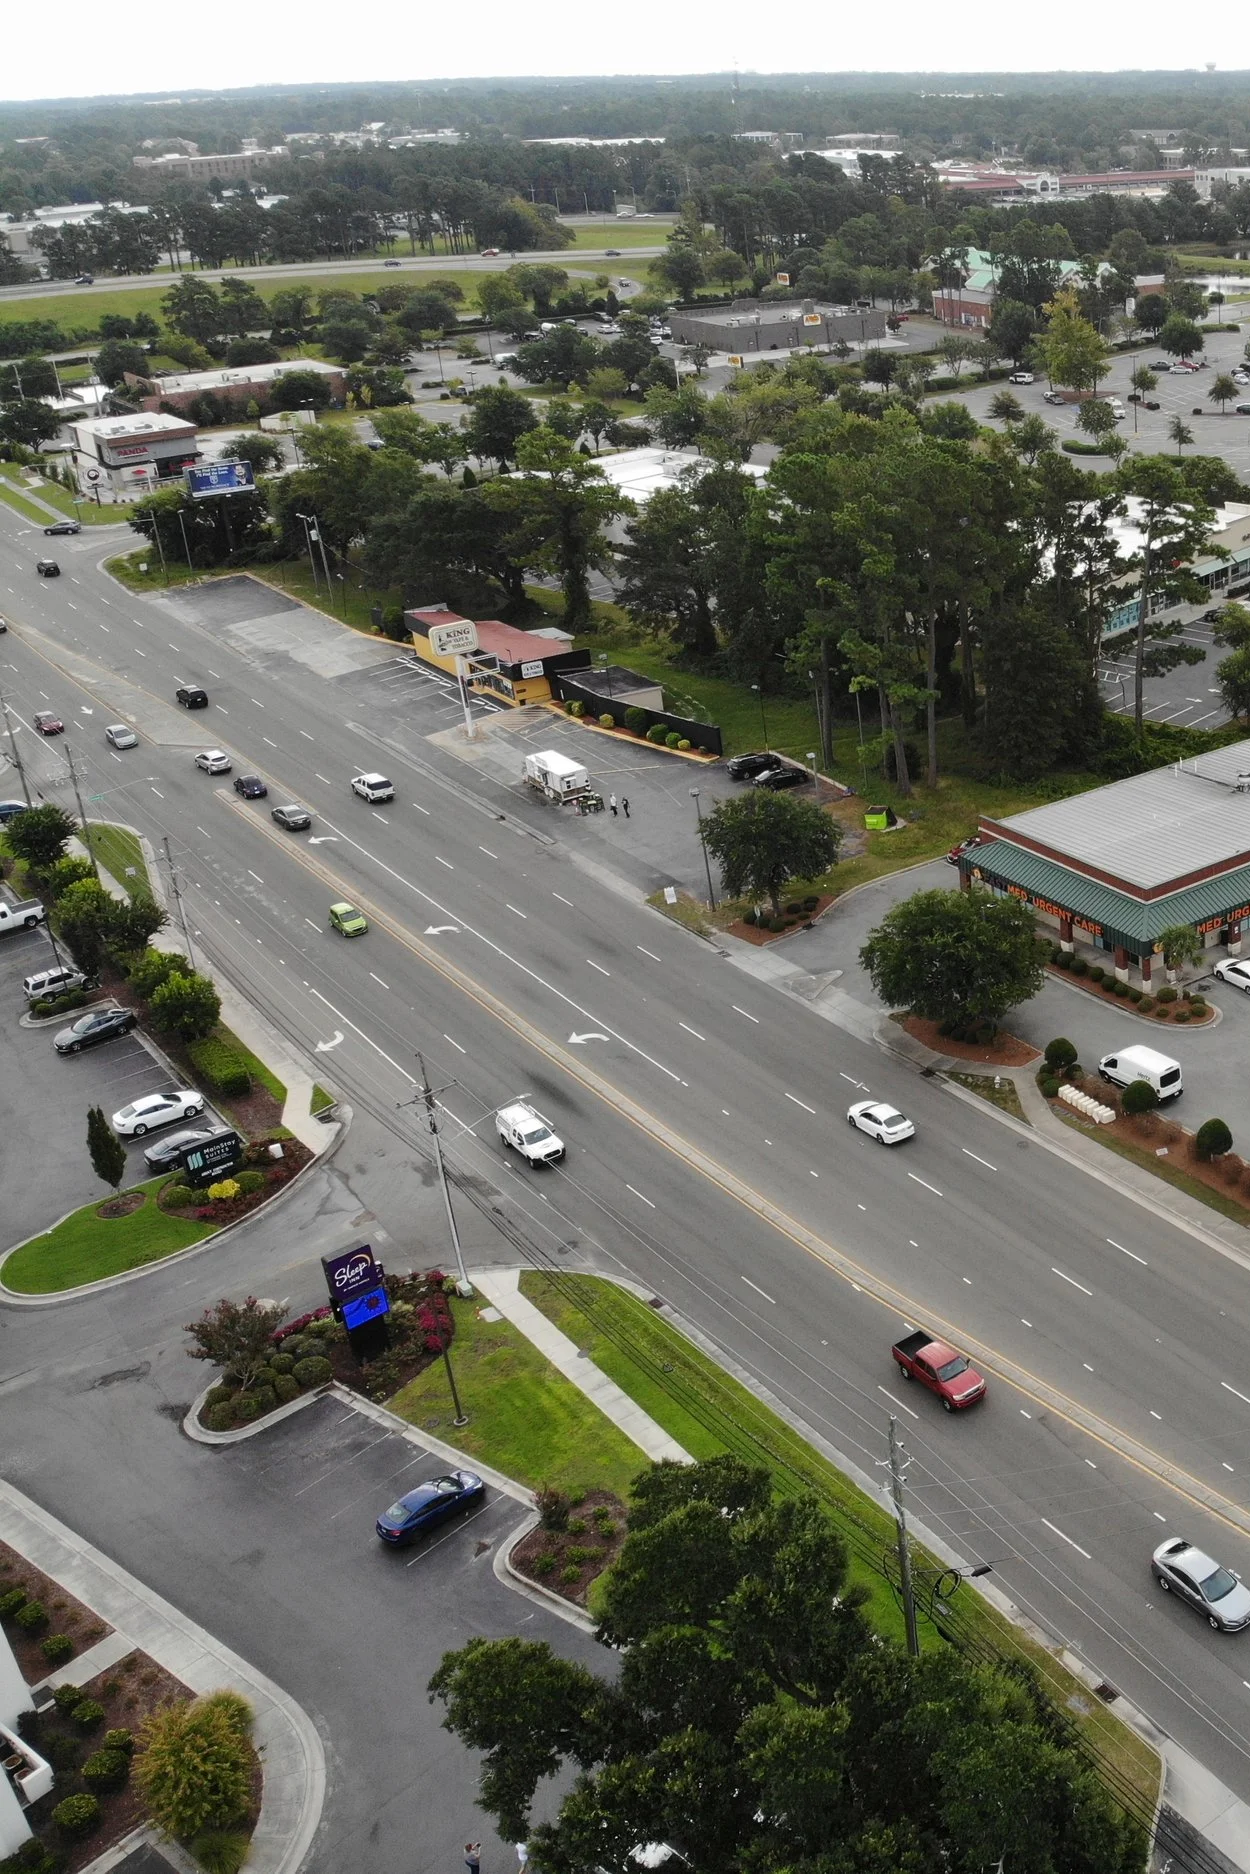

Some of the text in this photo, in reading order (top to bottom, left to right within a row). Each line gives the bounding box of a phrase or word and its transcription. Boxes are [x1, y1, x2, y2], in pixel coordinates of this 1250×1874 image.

[117, 446, 149, 456] PANDA
[1033, 895, 1072, 922] URGENT
[1074, 916, 1102, 936] CARE
[1136, 1071, 1151, 1081] Hertz
[204, 1140, 235, 1154] MainStay
[205, 1147, 229, 1159] SUITES
[334, 1262, 367, 1287] Sleep
[349, 1275, 360, 1284] INN
